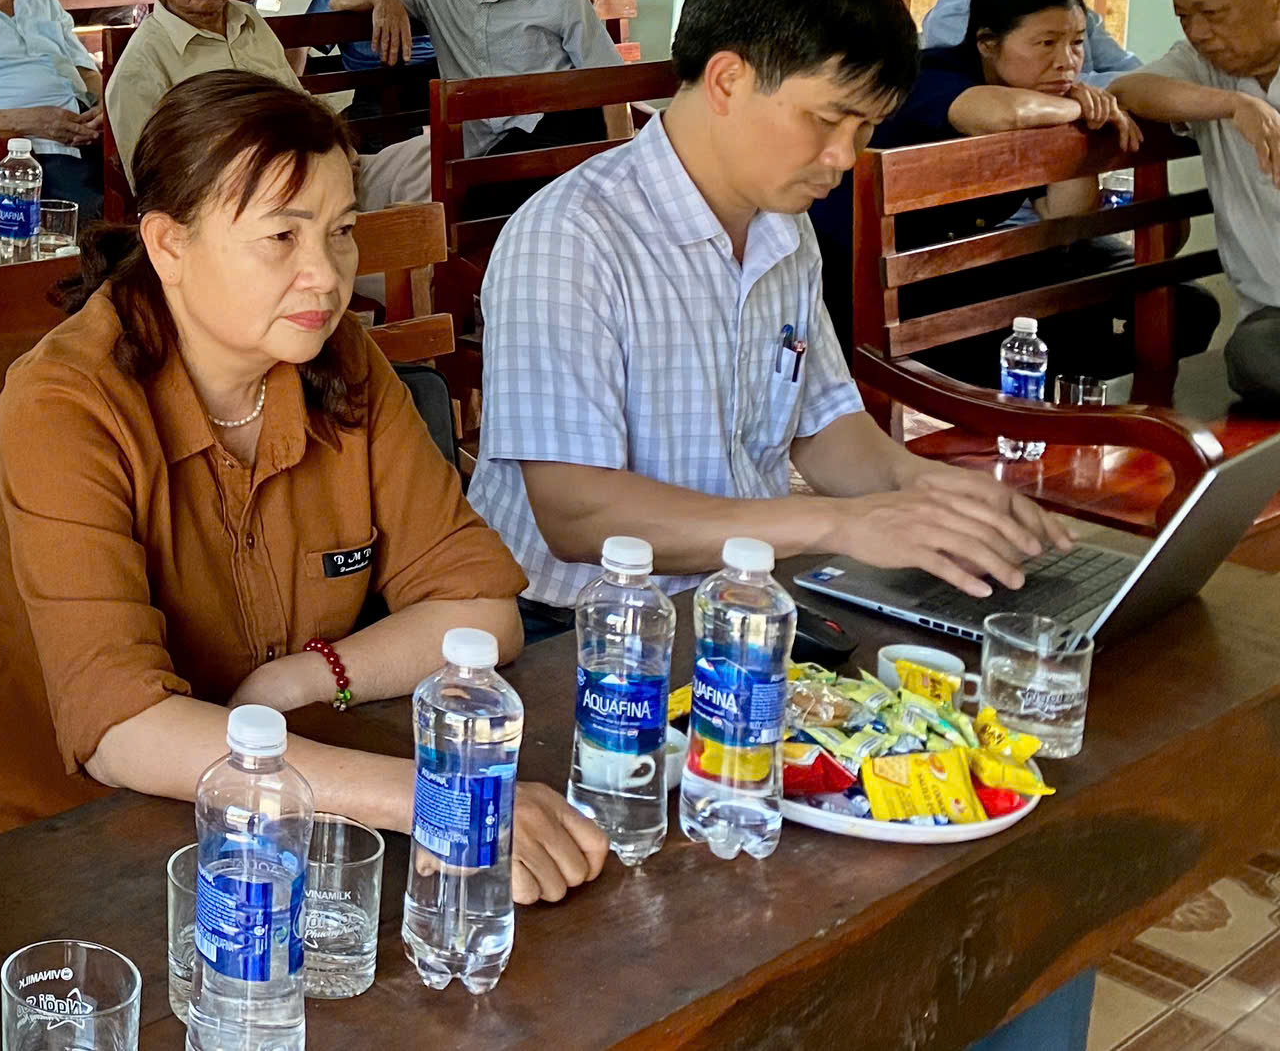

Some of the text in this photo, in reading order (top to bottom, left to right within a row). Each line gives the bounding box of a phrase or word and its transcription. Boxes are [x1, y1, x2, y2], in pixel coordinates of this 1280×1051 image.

[582, 688, 652, 720] AQUAFINA
[693, 676, 740, 715] UAFINA
[304, 889, 352, 900] VINAMILK
